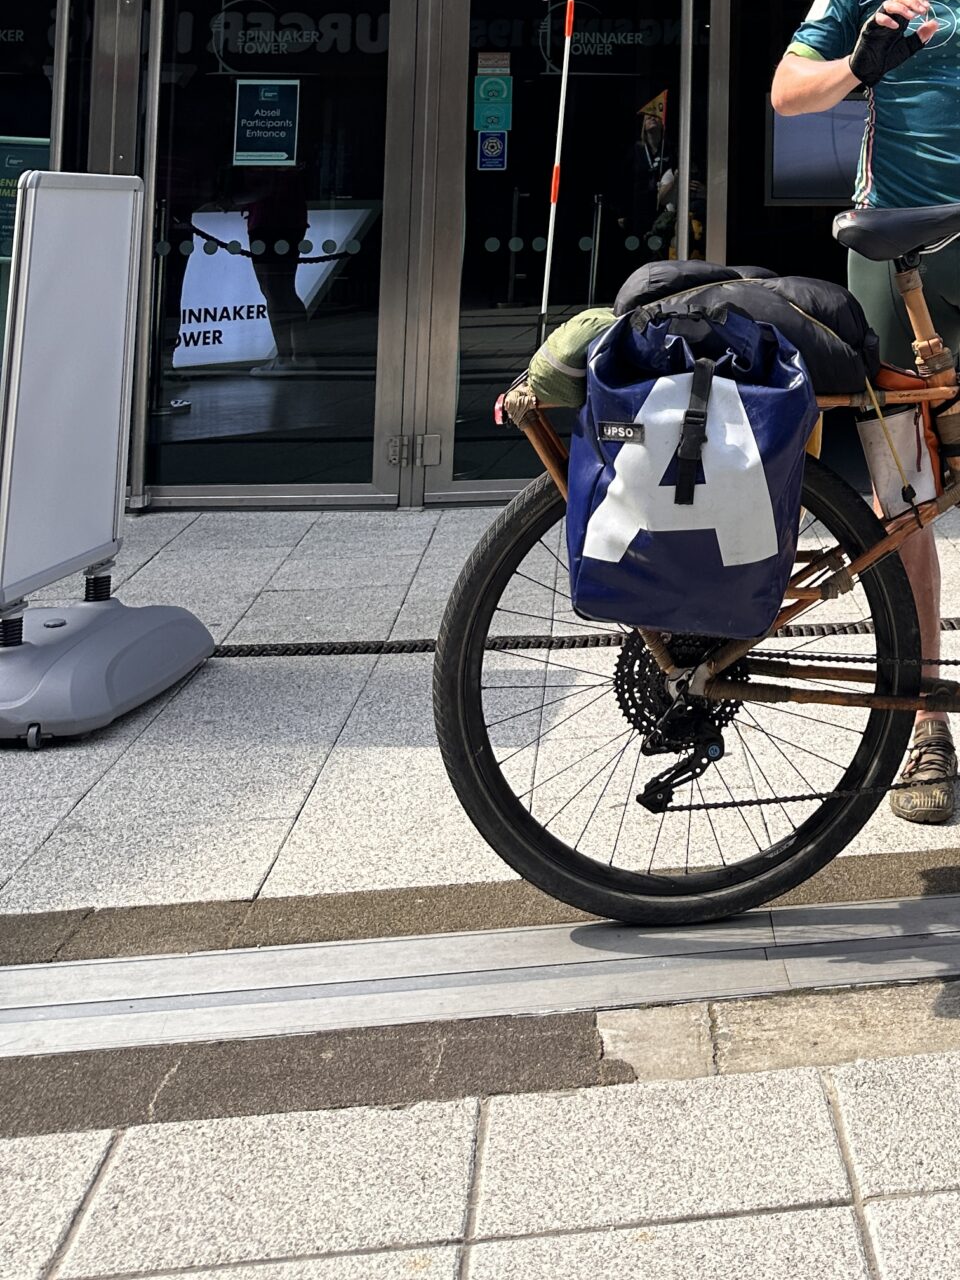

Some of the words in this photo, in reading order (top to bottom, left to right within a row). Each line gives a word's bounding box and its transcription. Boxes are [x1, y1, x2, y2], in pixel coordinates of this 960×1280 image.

[236, 30, 320, 43] SPINNAKER
[572, 32, 643, 44] PINNAKER
[237, 42, 289, 55] TOWER
[571, 43, 613, 56] OWER
[240, 118, 293, 129] Participants
[245, 129, 287, 138] Entrance
[182, 304, 267, 325] INNAKER
[603, 425, 634, 437] UPSO
